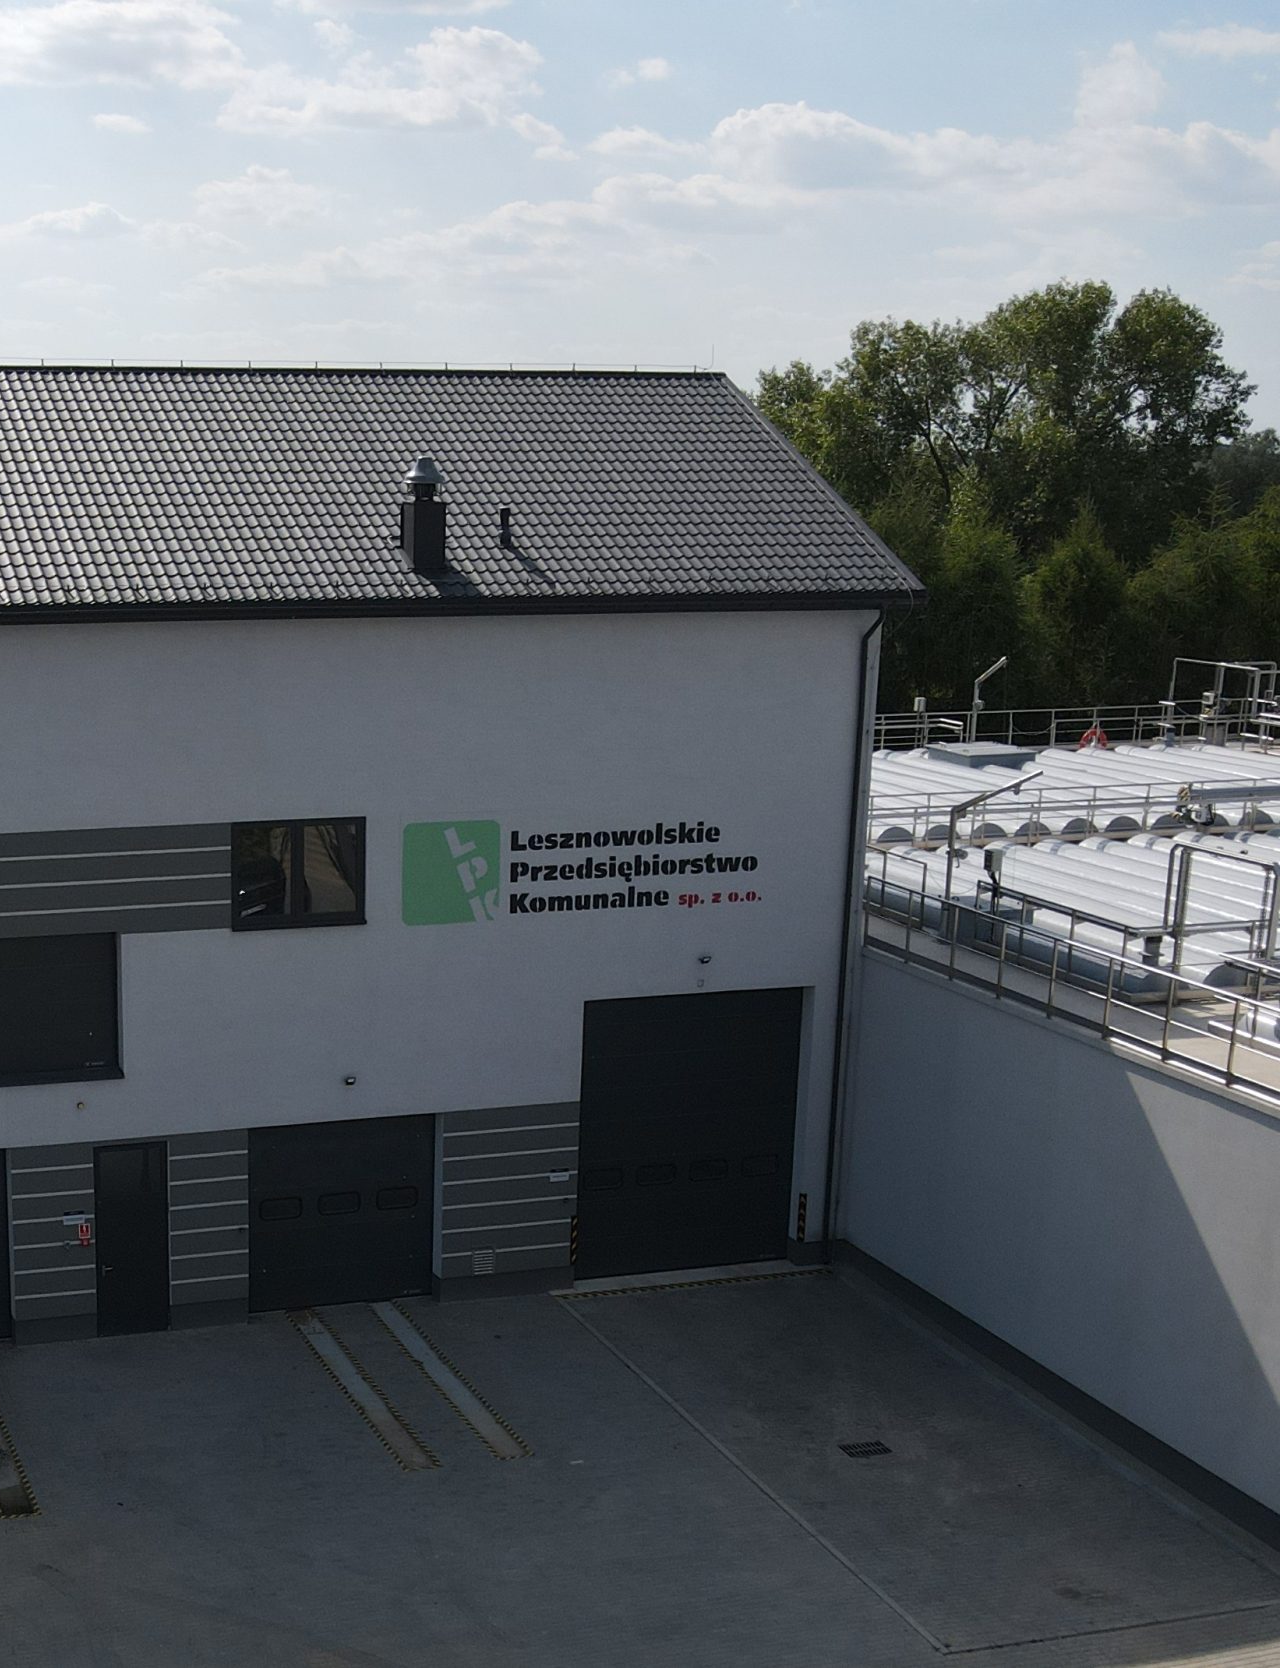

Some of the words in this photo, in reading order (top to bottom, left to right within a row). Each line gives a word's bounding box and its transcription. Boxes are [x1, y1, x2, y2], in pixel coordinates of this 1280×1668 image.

[510, 822, 721, 852] Lesznowolskie
[509, 853, 758, 883] Przedsiębiorstwo
[509, 886, 670, 915] Komunalne
[678, 894, 705, 909] sp.
[711, 892, 722, 904] z
[727, 891, 762, 903] o.o.
